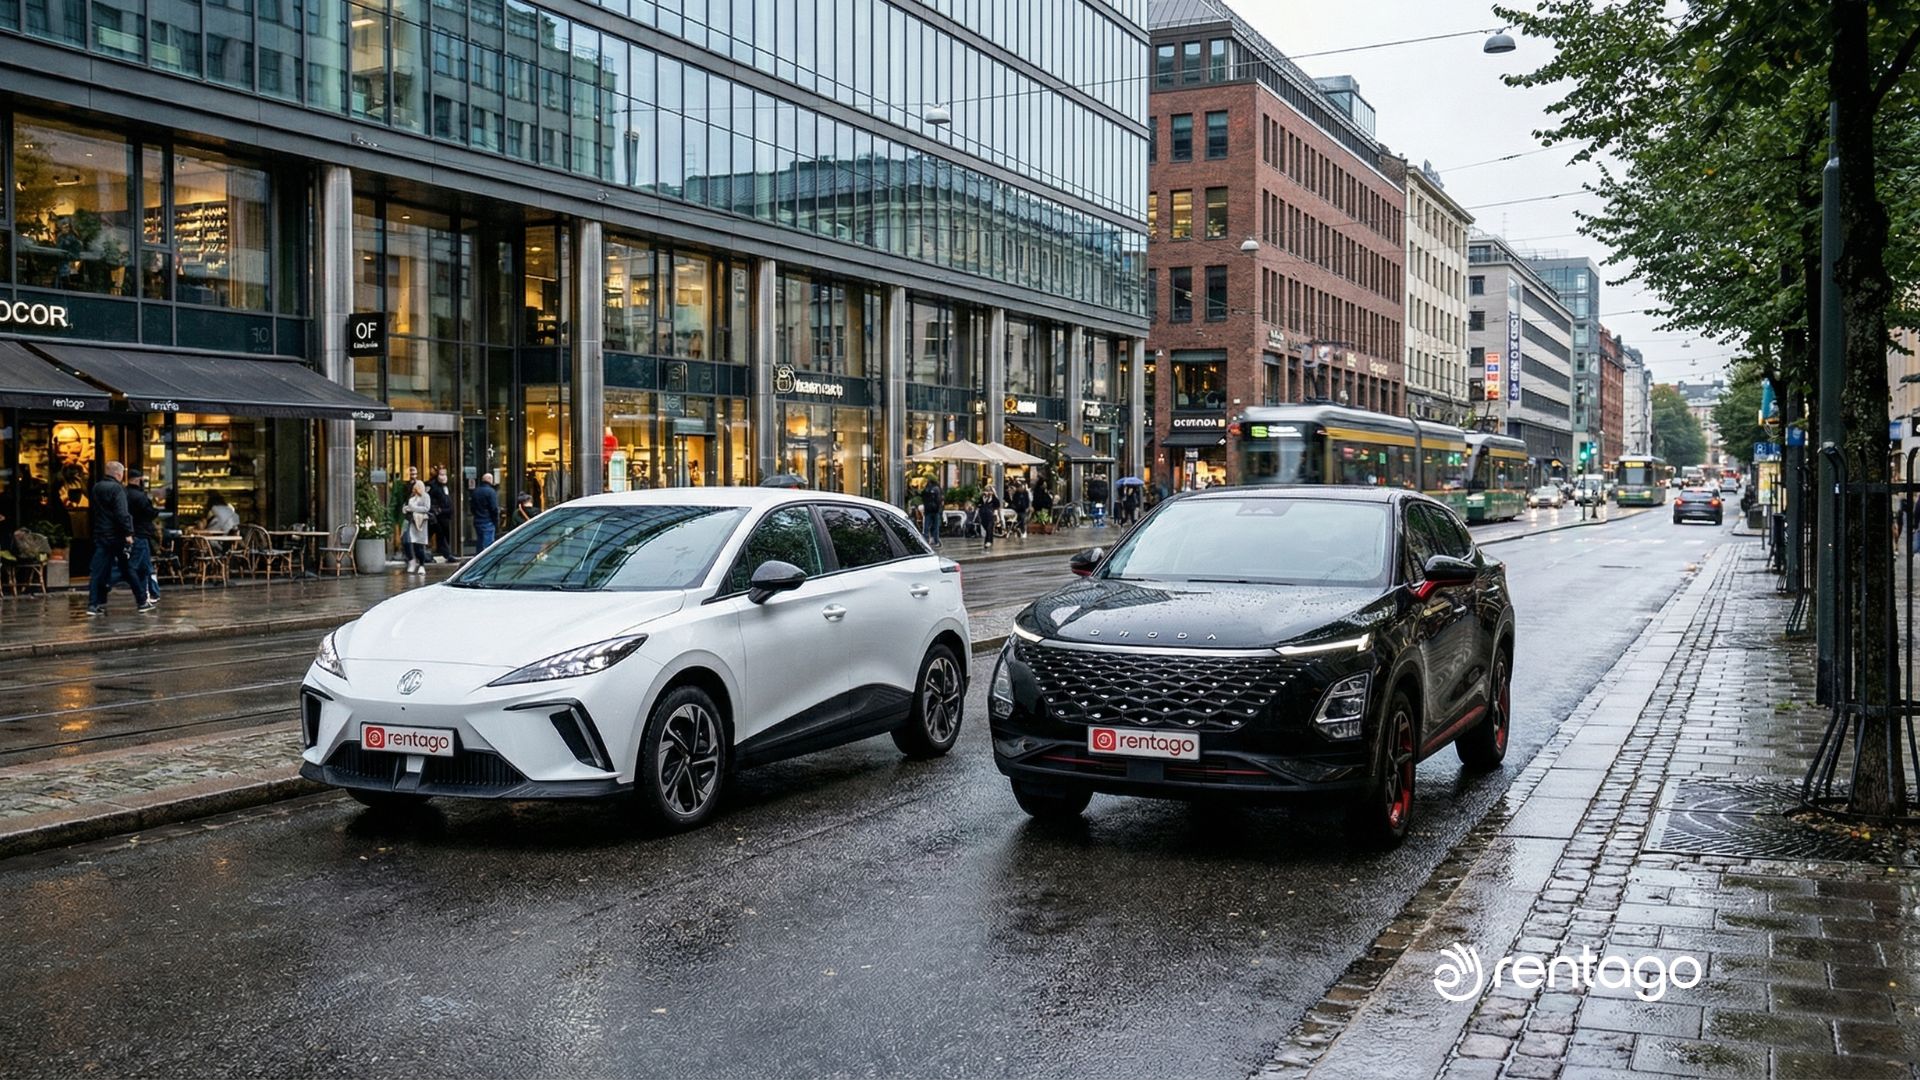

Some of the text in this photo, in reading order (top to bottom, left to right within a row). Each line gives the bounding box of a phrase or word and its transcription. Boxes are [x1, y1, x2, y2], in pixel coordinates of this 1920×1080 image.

[356, 322, 377, 339] OF
[388, 732, 449, 753] rentago
[1120, 734, 1195, 756] rentago
